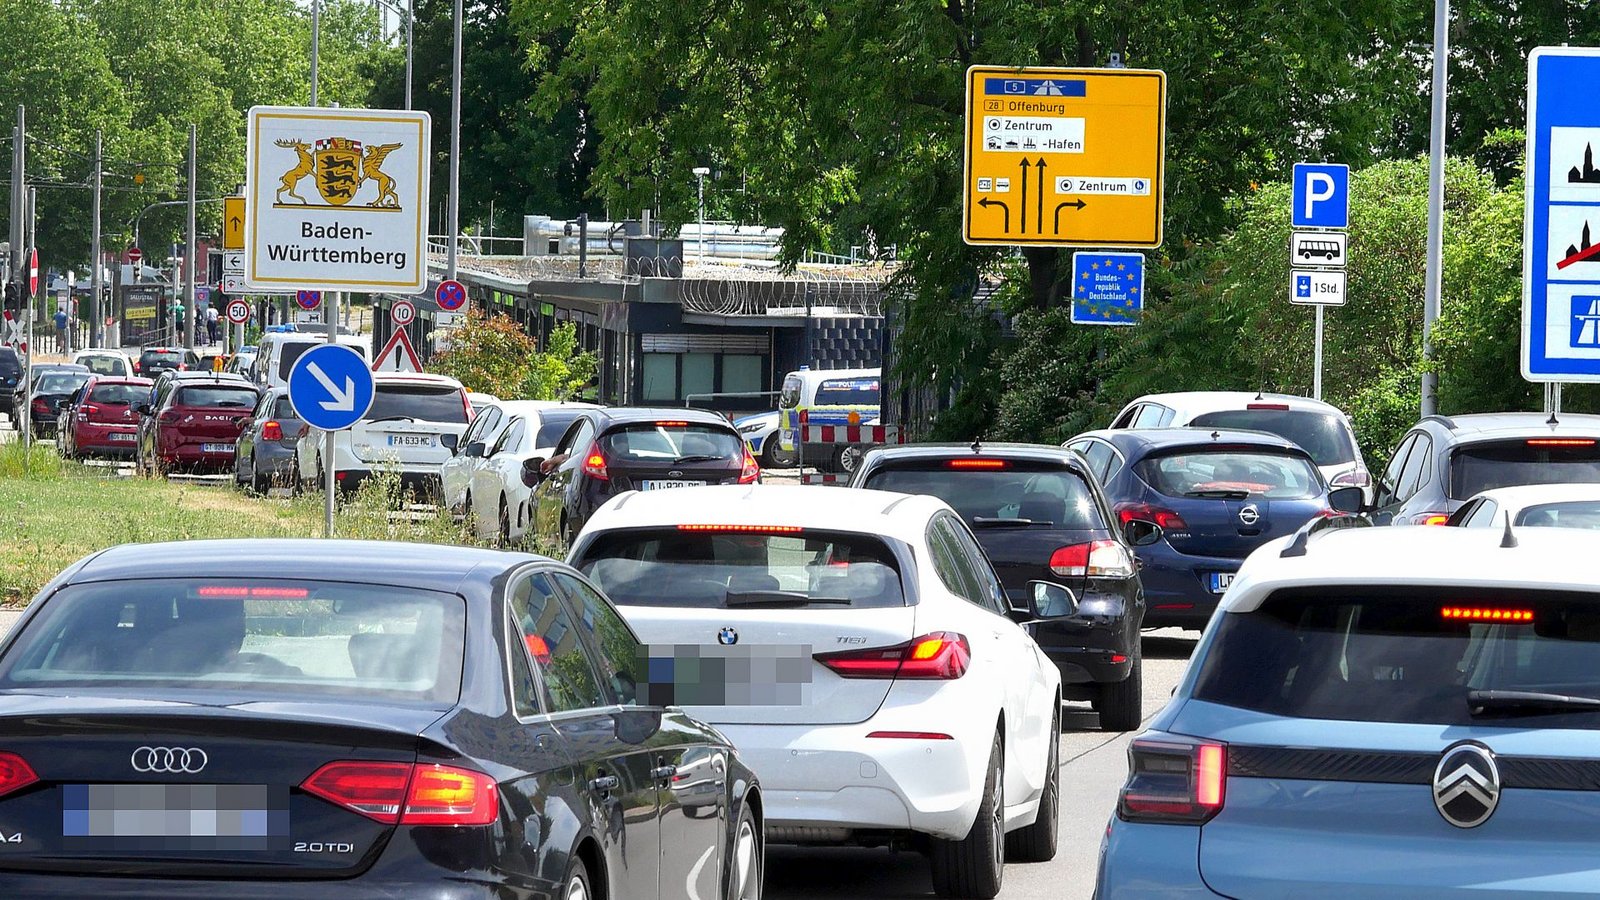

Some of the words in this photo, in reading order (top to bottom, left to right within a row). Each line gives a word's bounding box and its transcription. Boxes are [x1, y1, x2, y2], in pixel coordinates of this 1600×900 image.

[1011, 82, 1018, 92] 5
[988, 102, 999, 110] 28
[1008, 101, 1066, 114] Offenburg
[1004, 120, 1053, 132] Zentrum
[1042, 138, 1081, 149] -Hafen
[1079, 180, 1127, 192] Zentrum
[1305, 172, 1335, 218] P
[301, 221, 373, 238] Baden-
[268, 243, 407, 269] Württemberg
[1095, 273, 1122, 282] Bundes-
[1095, 283, 1121, 292] republik
[1320, 283, 1339, 293] Std.
[1089, 292, 1127, 301] Deutschland
[232, 305, 246, 317] 50
[397, 308, 409, 319] 10
